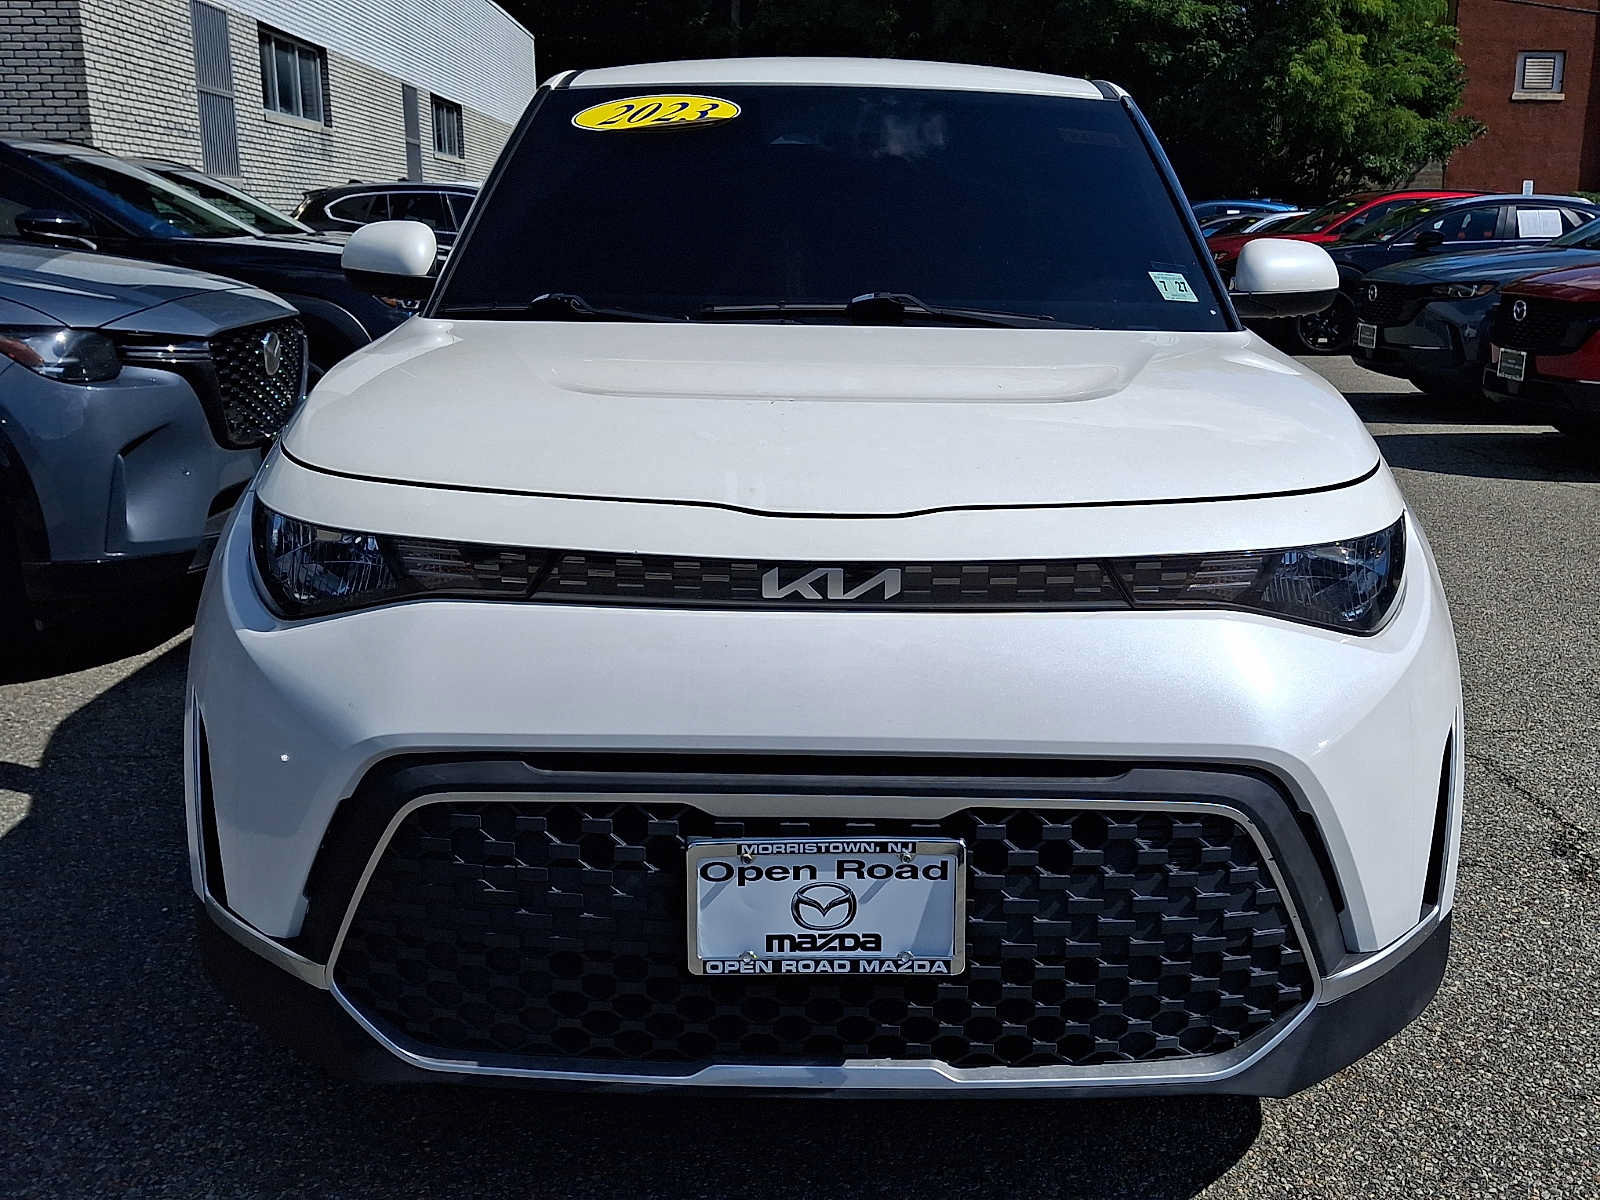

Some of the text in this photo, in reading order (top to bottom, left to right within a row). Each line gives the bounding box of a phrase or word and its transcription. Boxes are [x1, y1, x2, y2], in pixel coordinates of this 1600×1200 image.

[597, 102, 719, 126] 2023
[1159, 281, 1188, 292] 7 27
[888, 842, 913, 854] NJ
[700, 860, 950, 886] Open Road
[706, 961, 948, 974] OPEN ROAD MAZDA
